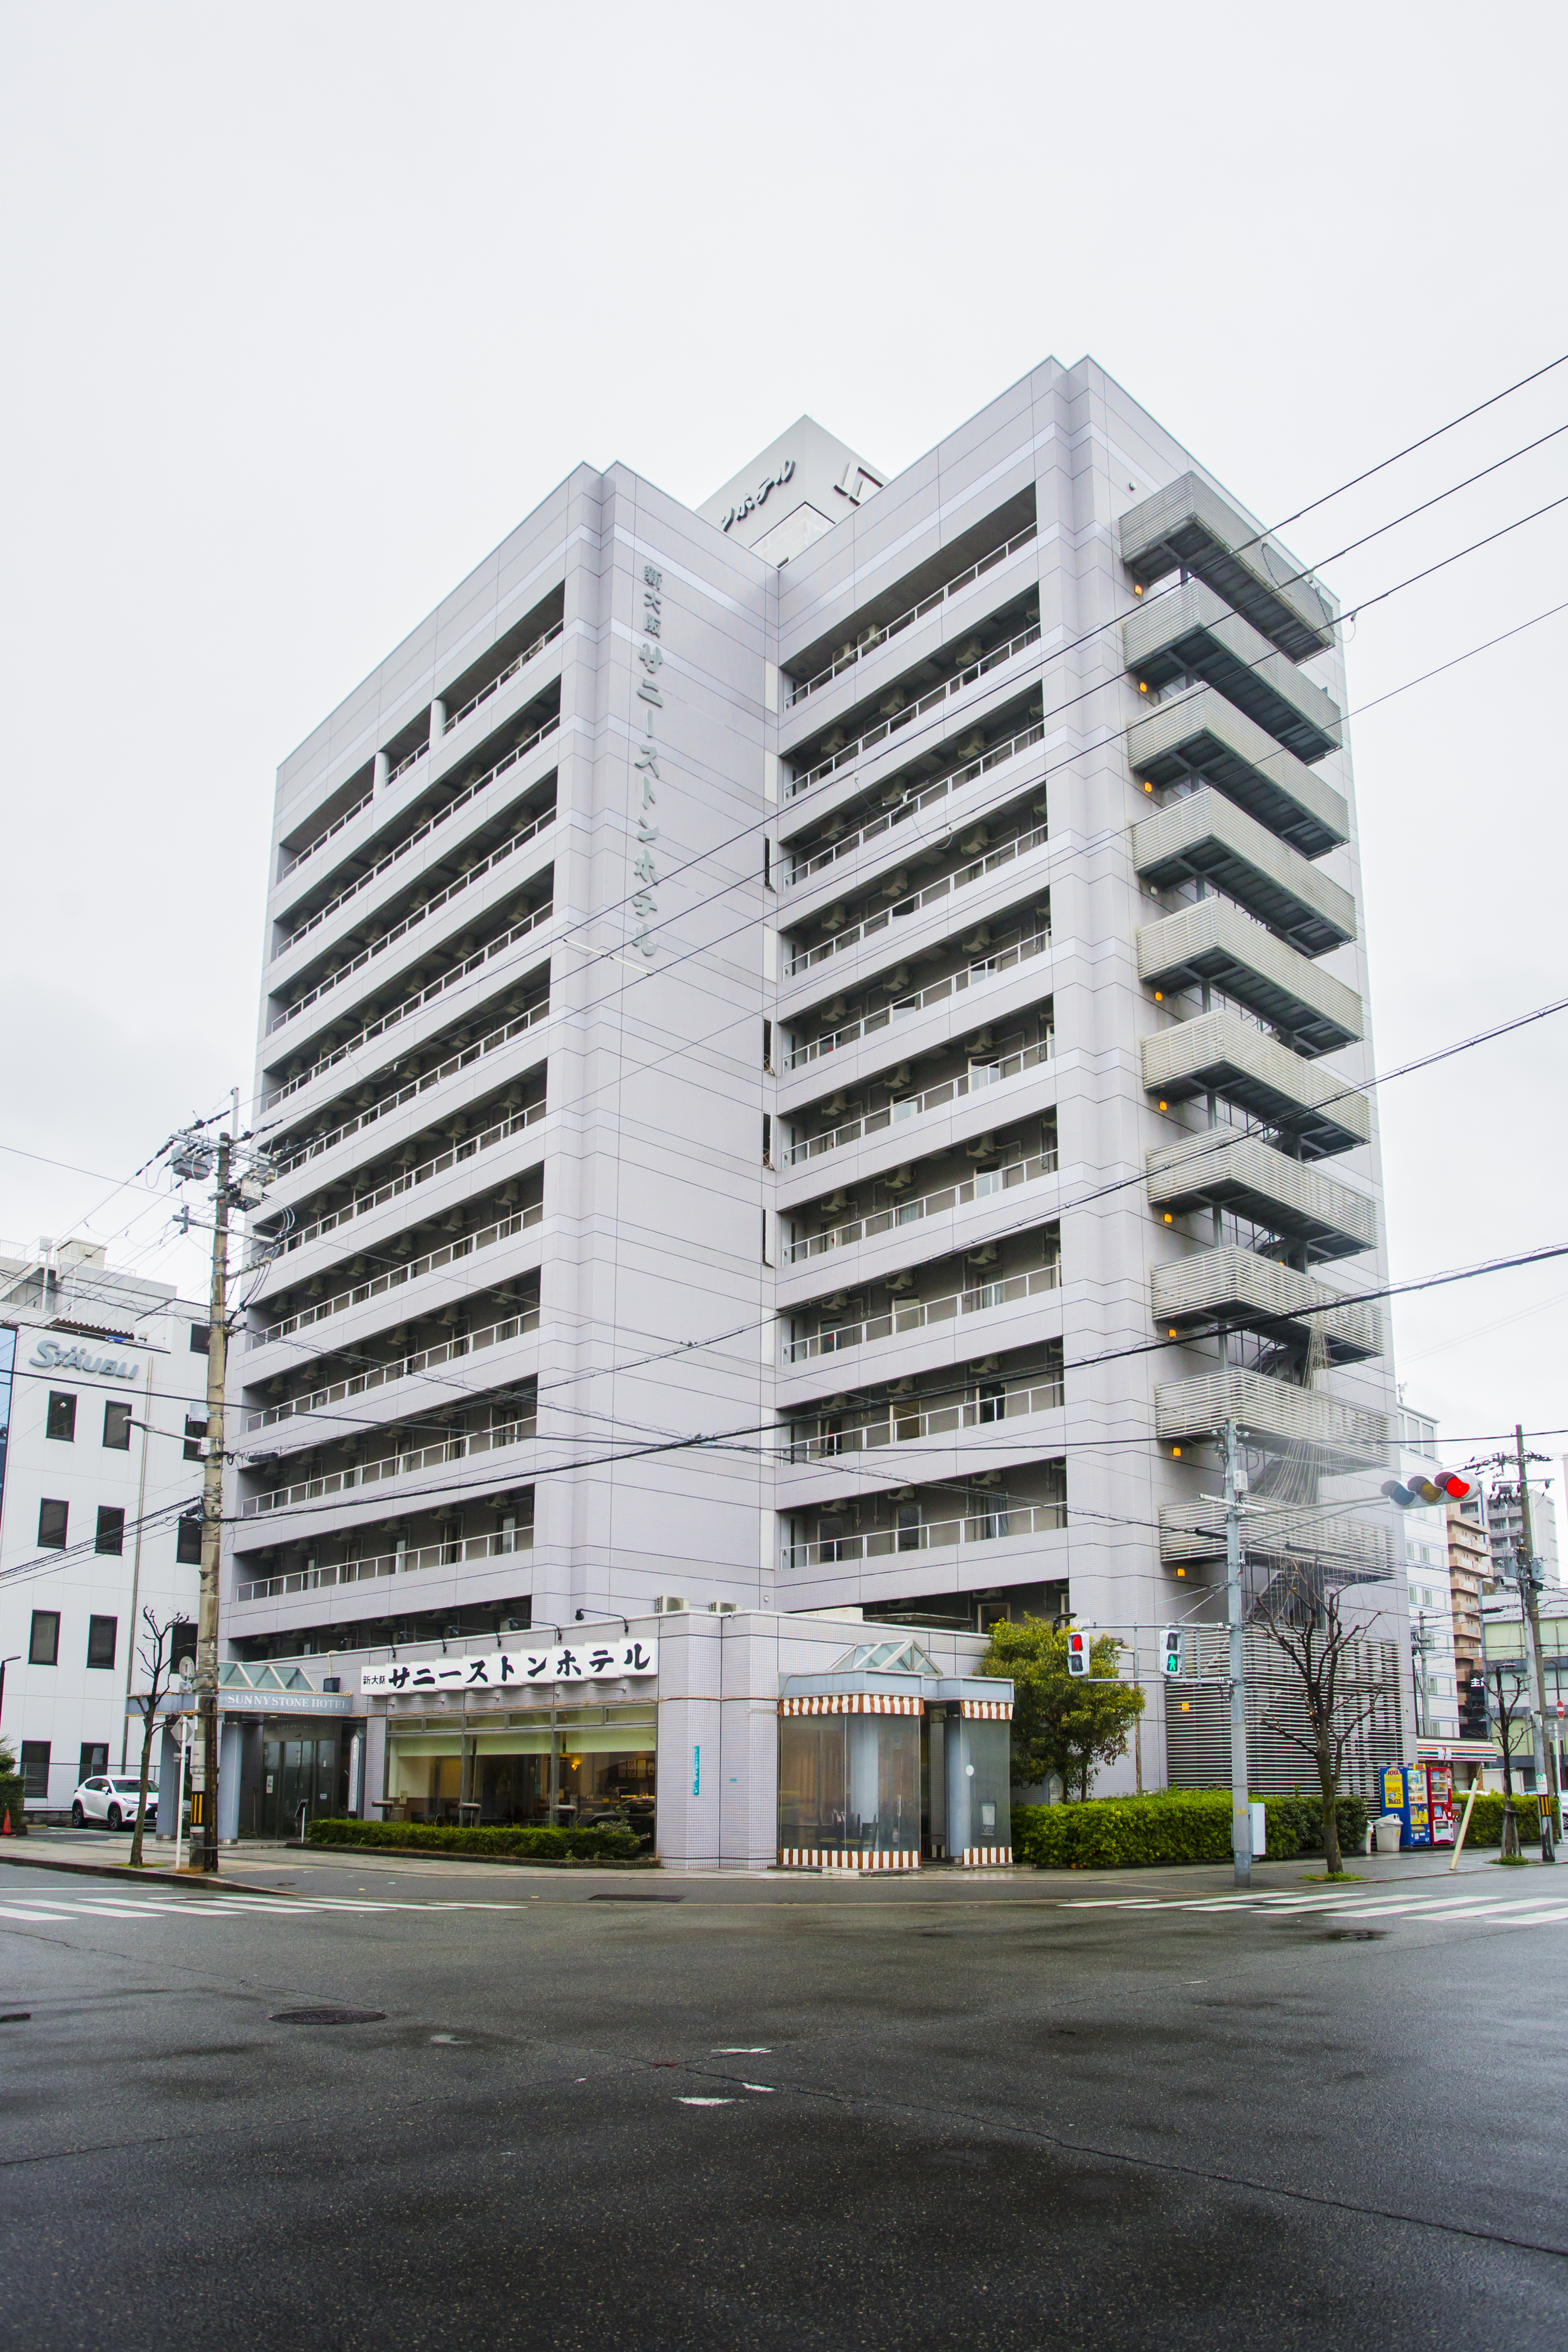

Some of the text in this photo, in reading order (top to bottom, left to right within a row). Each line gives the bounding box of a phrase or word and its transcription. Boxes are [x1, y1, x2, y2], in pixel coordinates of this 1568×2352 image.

[30, 1340, 139, 1379] STÄUBLI
[228, 1695, 349, 1709] SUNNY STONE HOTEL
